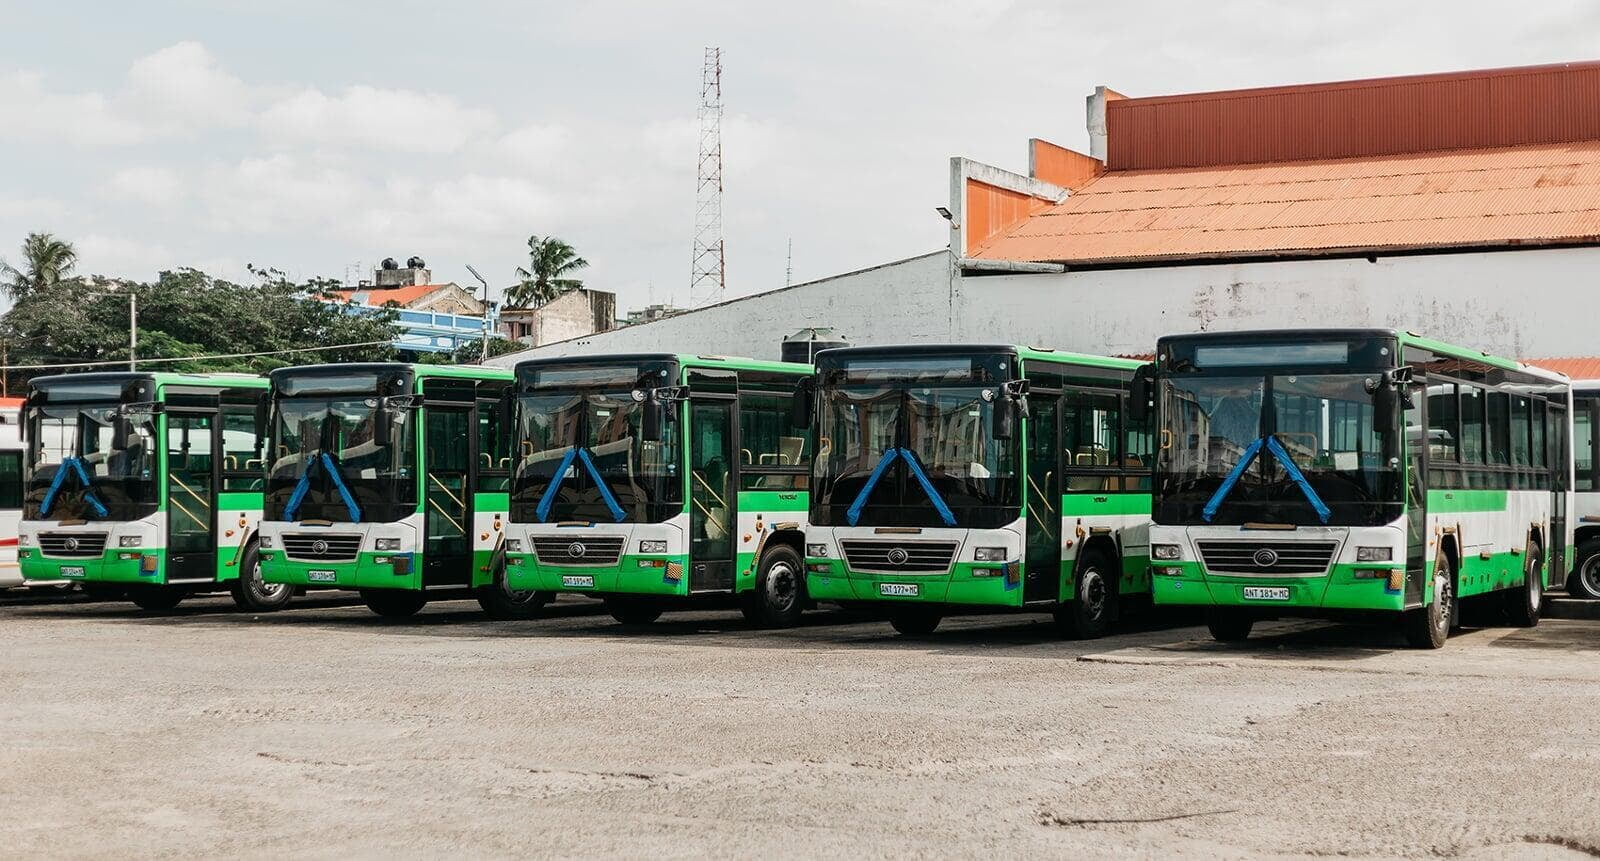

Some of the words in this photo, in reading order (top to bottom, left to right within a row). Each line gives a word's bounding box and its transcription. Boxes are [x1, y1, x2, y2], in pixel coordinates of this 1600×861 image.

[881, 585, 892, 593] ANT
[894, 585, 904, 594] 177
[909, 586, 917, 594] MC
[1244, 589, 1258, 597] ANT
[1260, 589, 1273, 598] 181
[1279, 589, 1289, 598] MC
